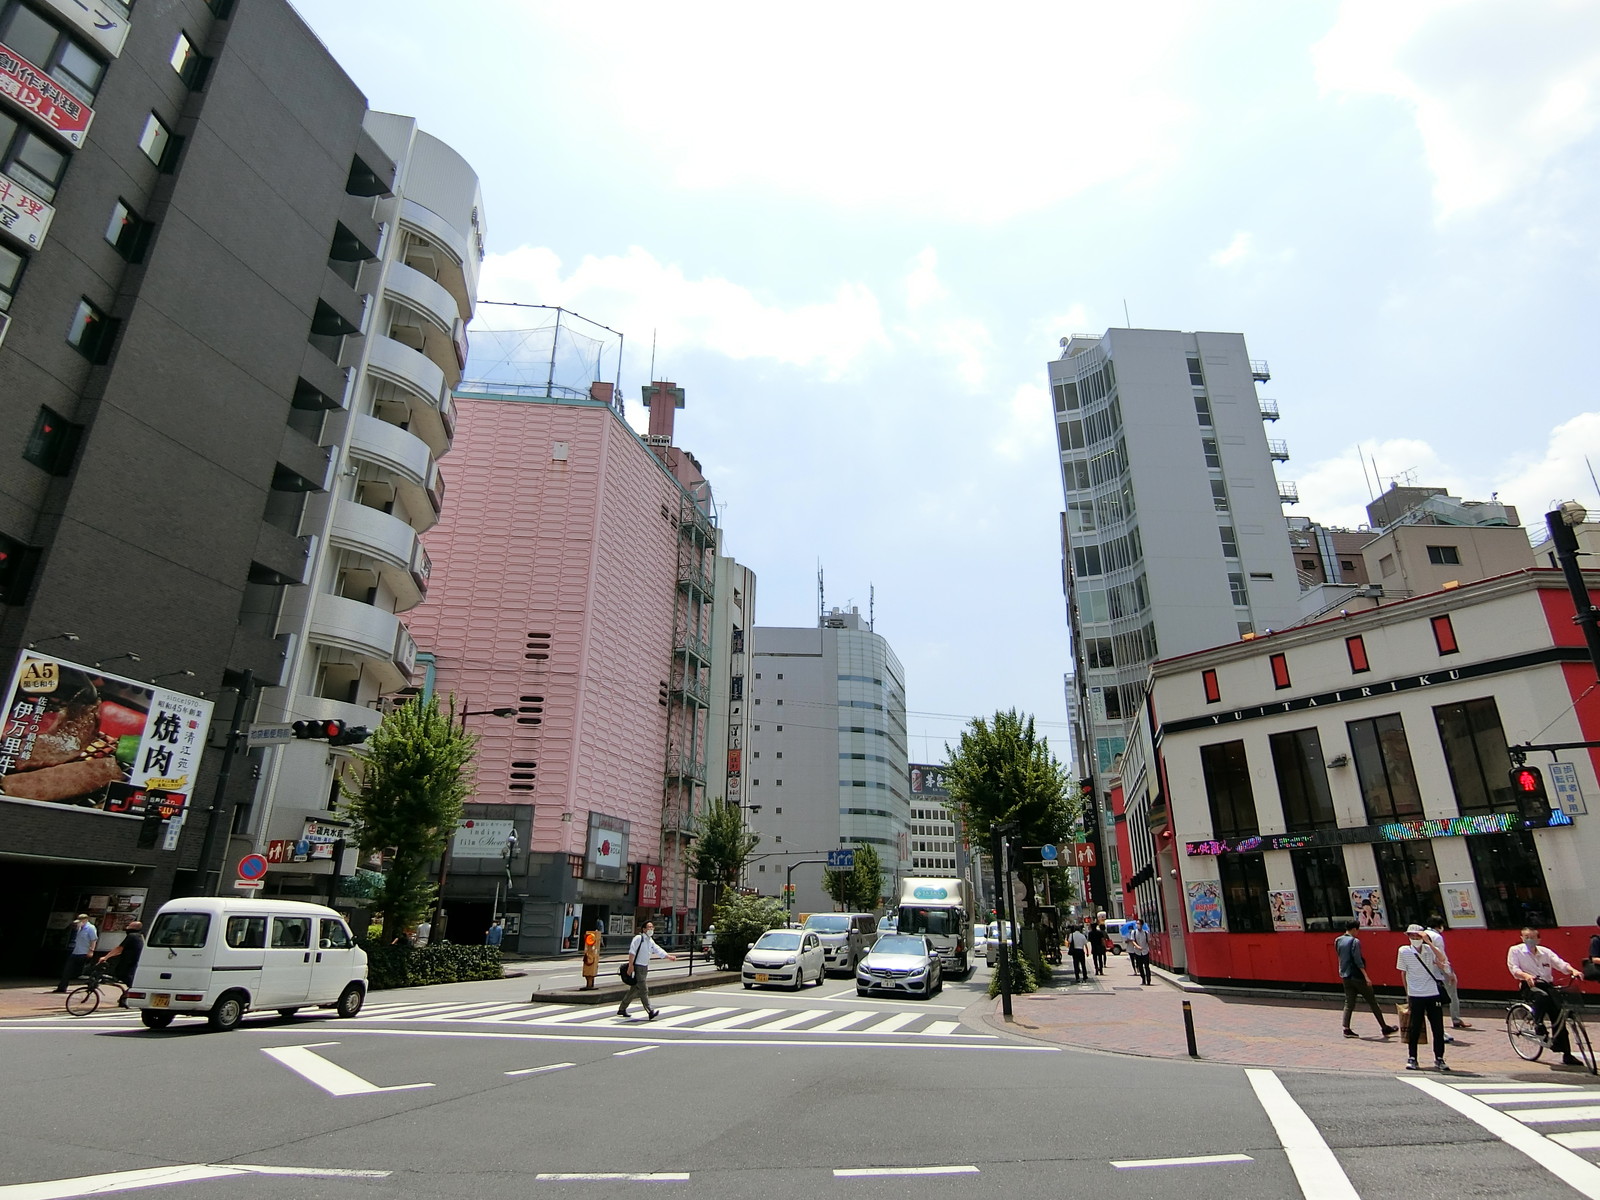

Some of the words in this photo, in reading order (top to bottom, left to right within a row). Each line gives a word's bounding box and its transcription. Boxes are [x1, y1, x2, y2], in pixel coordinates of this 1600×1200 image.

[0, 54, 80, 120] 創作料理
[71, 133, 78, 142] 6
[29, 234, 37, 243] 5
[24, 663, 54, 679] A5
[0, 701, 34, 774] 伊万里牛
[20, 696, 48, 760] 佐賀牛の最高峰
[143, 710, 181, 777] 焼肉
[1553, 766, 1567, 792] 自転車
[1563, 765, 1577, 792] 歩行者
